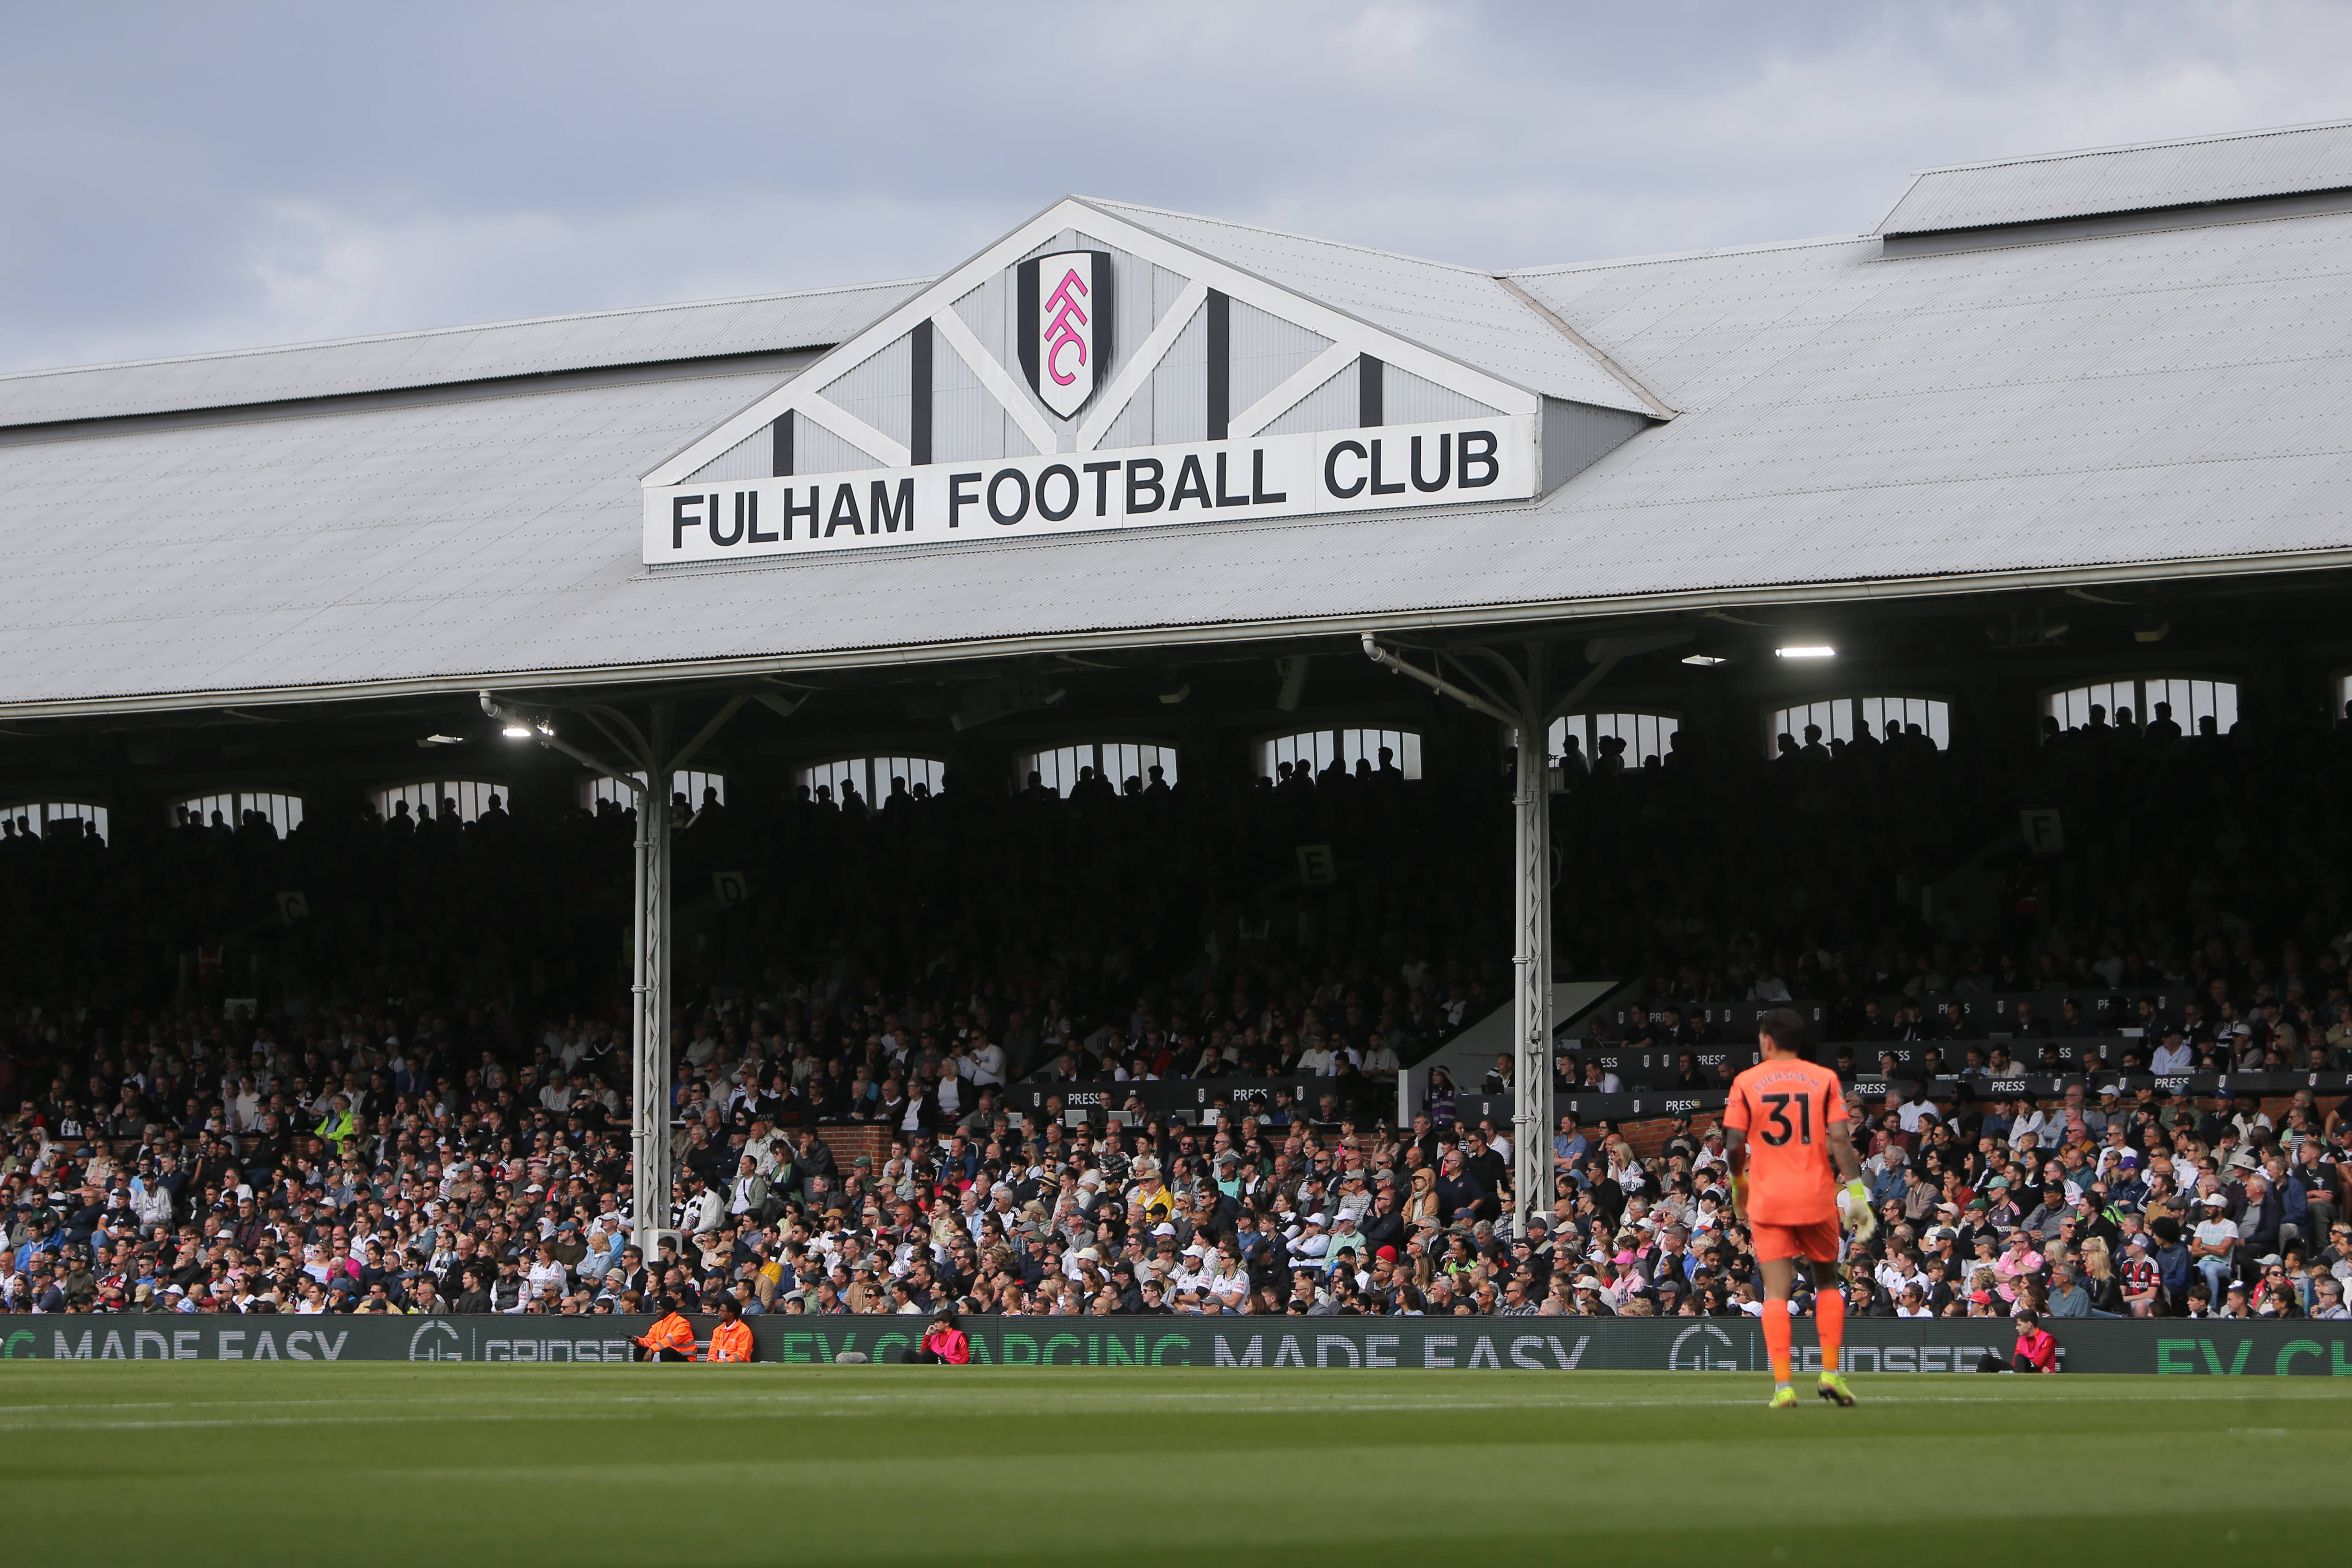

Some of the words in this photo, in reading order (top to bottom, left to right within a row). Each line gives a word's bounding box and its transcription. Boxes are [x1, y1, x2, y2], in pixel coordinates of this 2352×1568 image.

[672, 478, 914, 549] FULHAM
[949, 449, 1287, 528] FOOTBALL
[1324, 430, 1499, 499] CLUB
[2032, 815, 2050, 846] F
[1305, 851, 1327, 880] E
[720, 878, 741, 904] D
[1753, 1071, 1806, 1092] EDERSON
[1854, 1083, 1886, 1094] PRESS
[1991, 1081, 2026, 1092] PRESS
[1068, 1093, 1100, 1105] PRESS
[1760, 1092, 1811, 1146] 31
[54, 1330, 200, 1360] MADE
[1214, 1334, 1400, 1368] MADE
